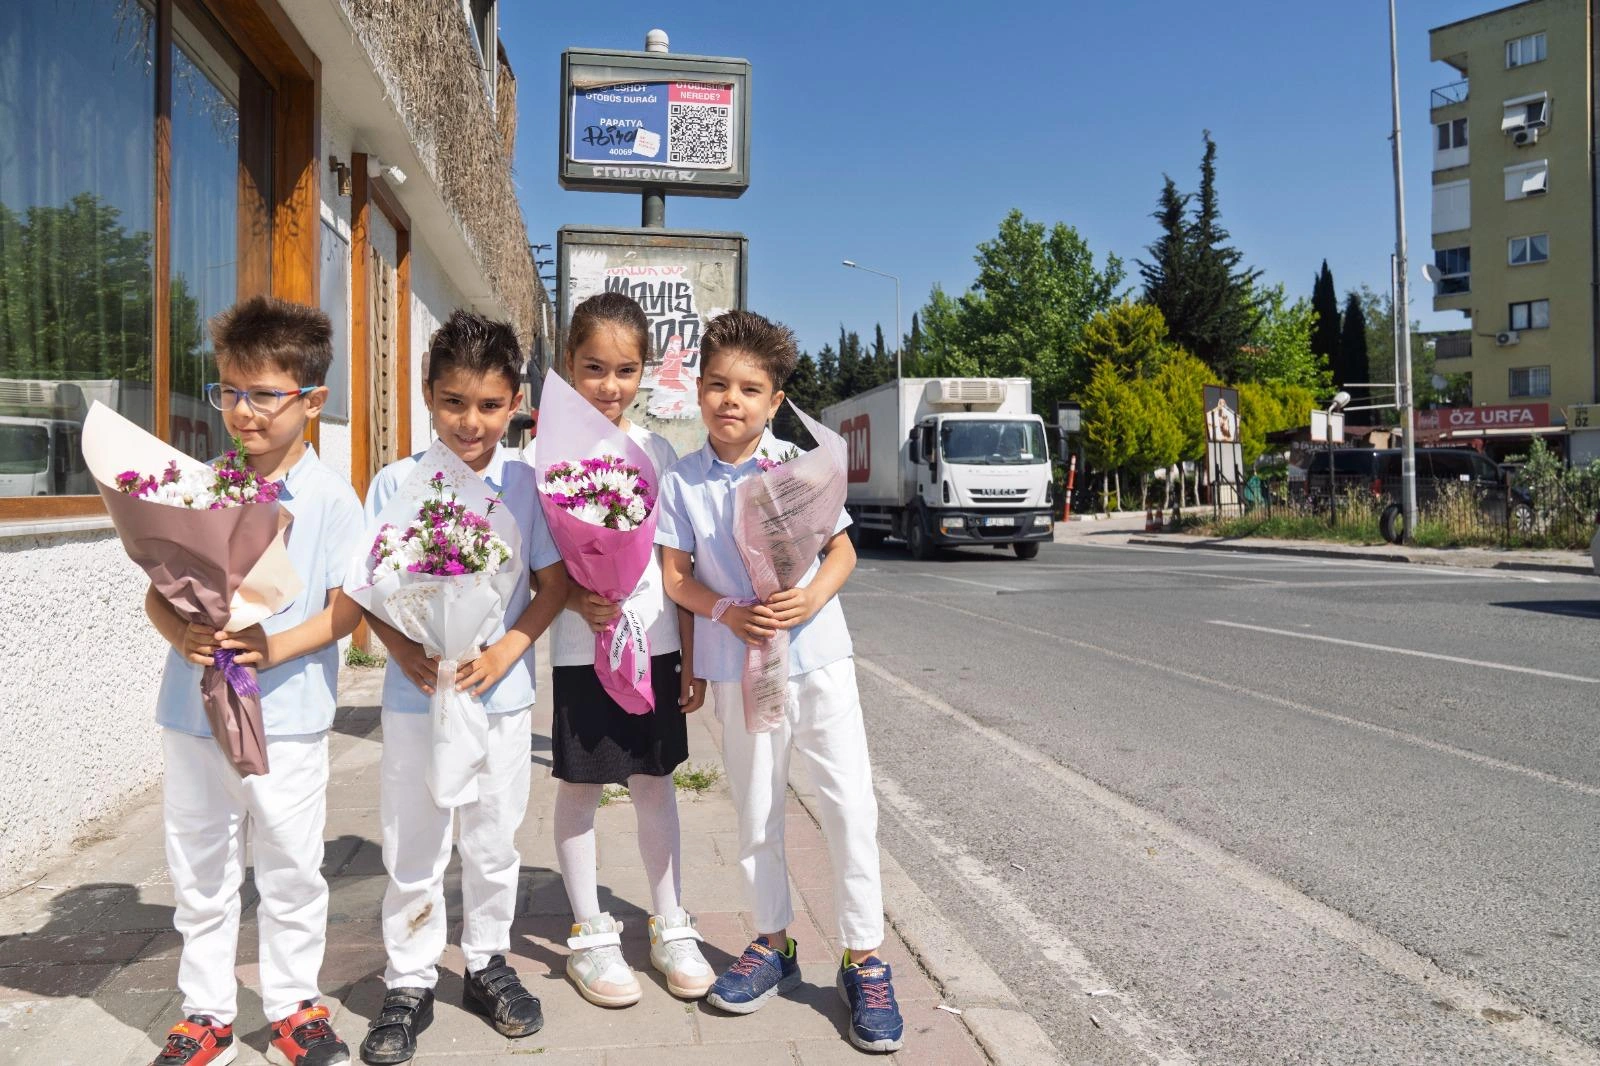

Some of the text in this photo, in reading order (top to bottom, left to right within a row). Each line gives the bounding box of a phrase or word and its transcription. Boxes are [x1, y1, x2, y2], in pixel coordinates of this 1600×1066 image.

[623, 95, 657, 104] DURAĞI
[680, 92, 720, 101] NEREDE?
[600, 118, 643, 128] PAPATYA
[609, 148, 632, 156] 40069
[1450, 409, 1475, 425] ÖZ
[1481, 409, 1534, 423] URFA
[982, 488, 1017, 496] IVECO
